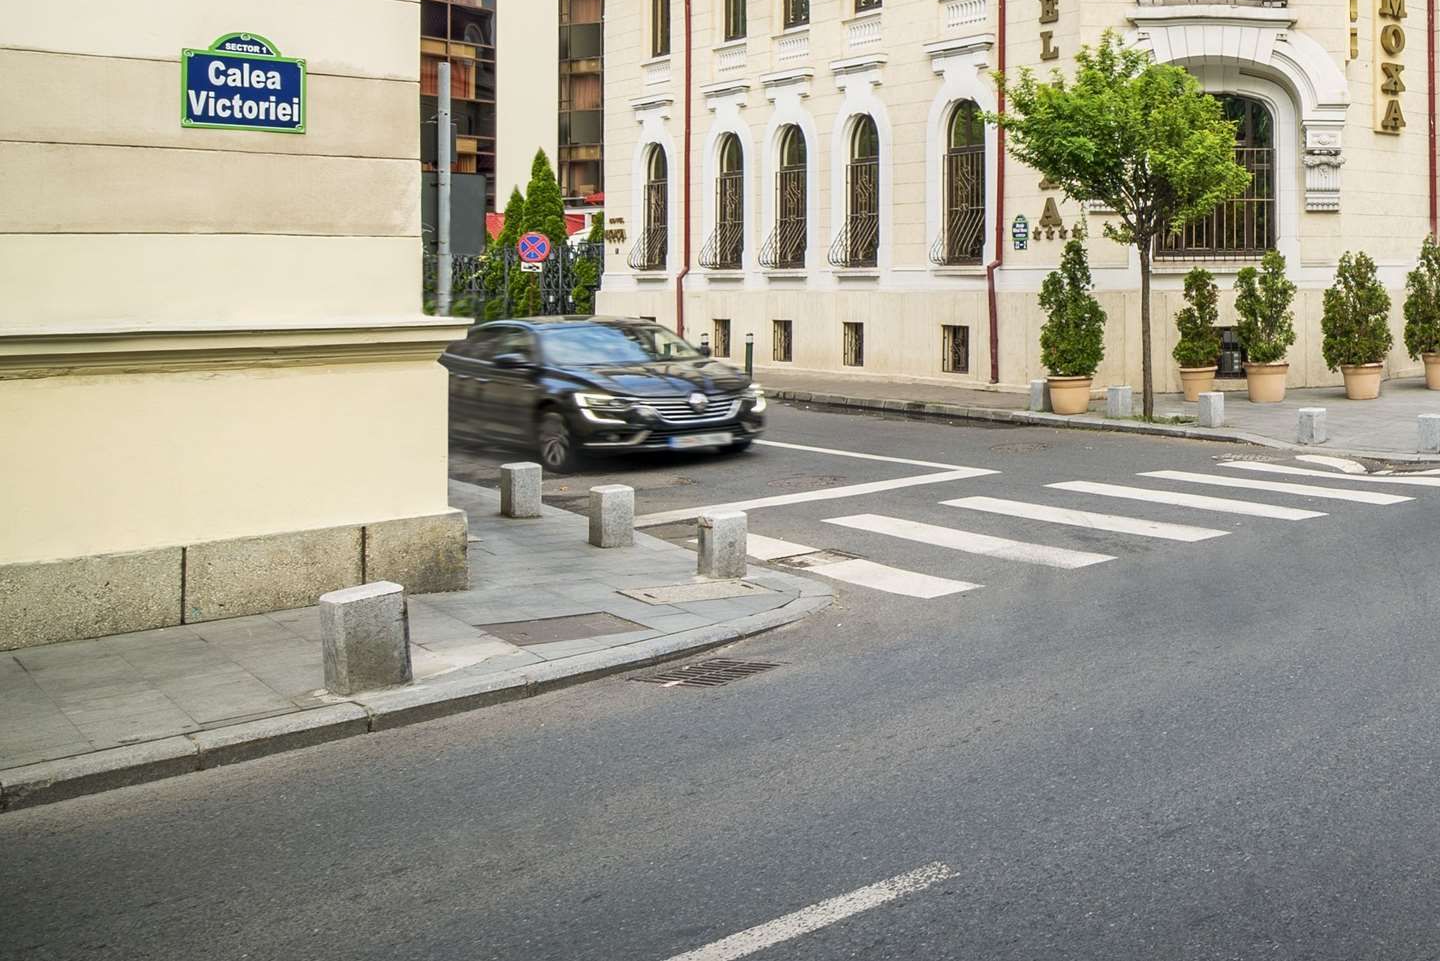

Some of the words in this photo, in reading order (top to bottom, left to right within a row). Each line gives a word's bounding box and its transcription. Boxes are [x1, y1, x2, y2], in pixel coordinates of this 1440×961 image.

[225, 42, 260, 53] SECTOR
[261, 46, 267, 54] 1
[208, 60, 281, 90] Calea
[187, 90, 300, 122] Victoriei
